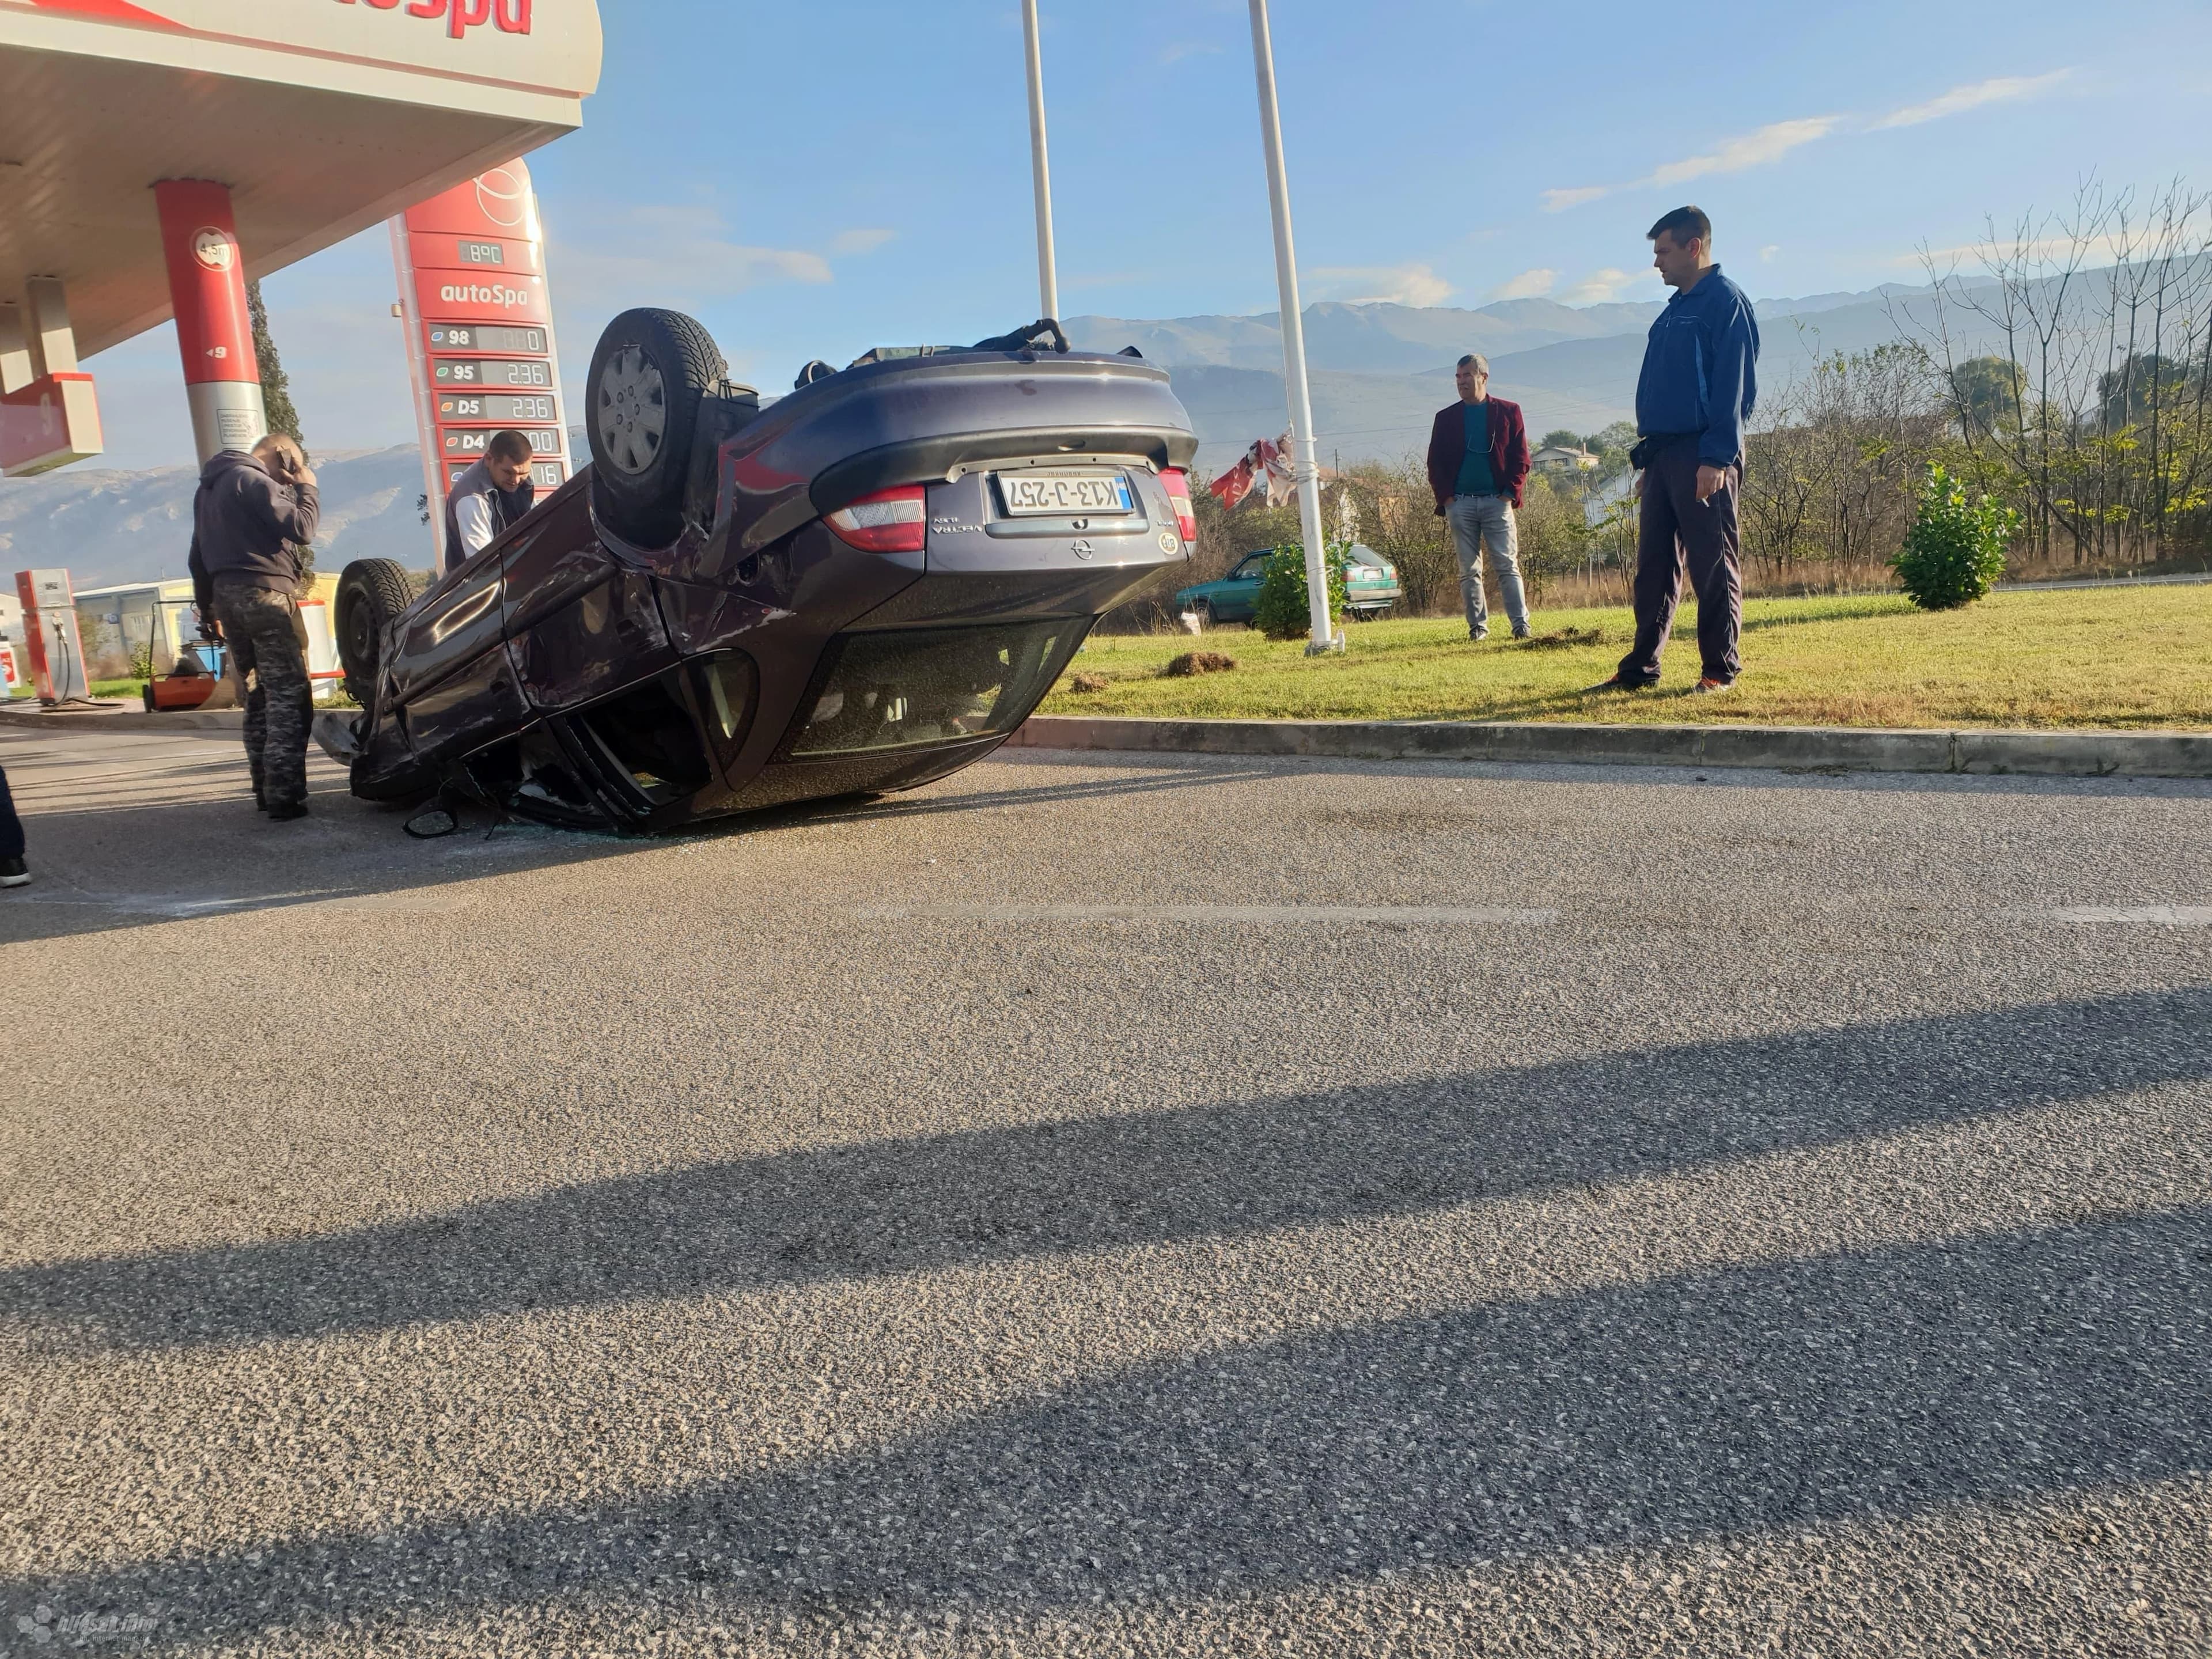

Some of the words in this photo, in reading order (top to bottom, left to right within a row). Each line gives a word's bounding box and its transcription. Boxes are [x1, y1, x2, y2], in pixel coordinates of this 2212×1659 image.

[440, 284, 528, 309] autoSpa
[449, 329, 469, 345] 98
[215, 346, 227, 358] 9
[454, 365, 474, 380] 95
[458, 400, 479, 414] D5
[463, 435, 484, 449] D4
[531, 465, 557, 484] 16
[1011, 481, 1118, 507] K13-J-257
